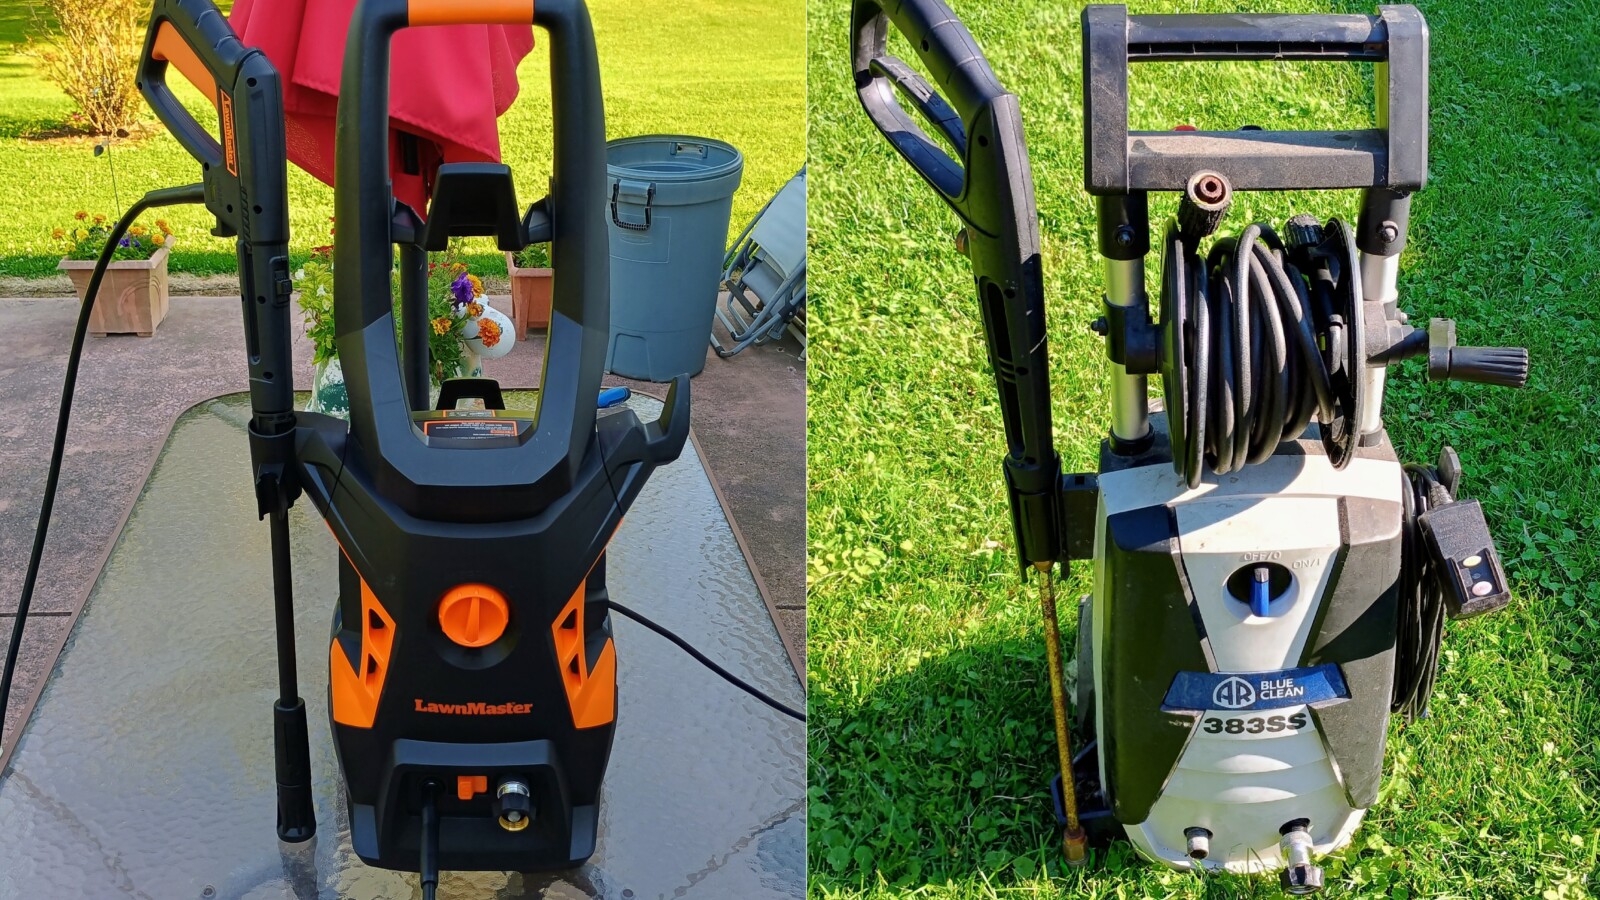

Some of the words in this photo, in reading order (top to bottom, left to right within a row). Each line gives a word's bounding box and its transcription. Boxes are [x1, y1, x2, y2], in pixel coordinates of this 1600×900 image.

[223, 100, 235, 165] LawnMaster
[1216, 680, 1252, 706] AR
[1260, 678, 1294, 691] BLUE
[1260, 686, 1304, 700] CLEAN
[414, 698, 533, 715] LawnMaster
[1203, 713, 1307, 735] 383SS
